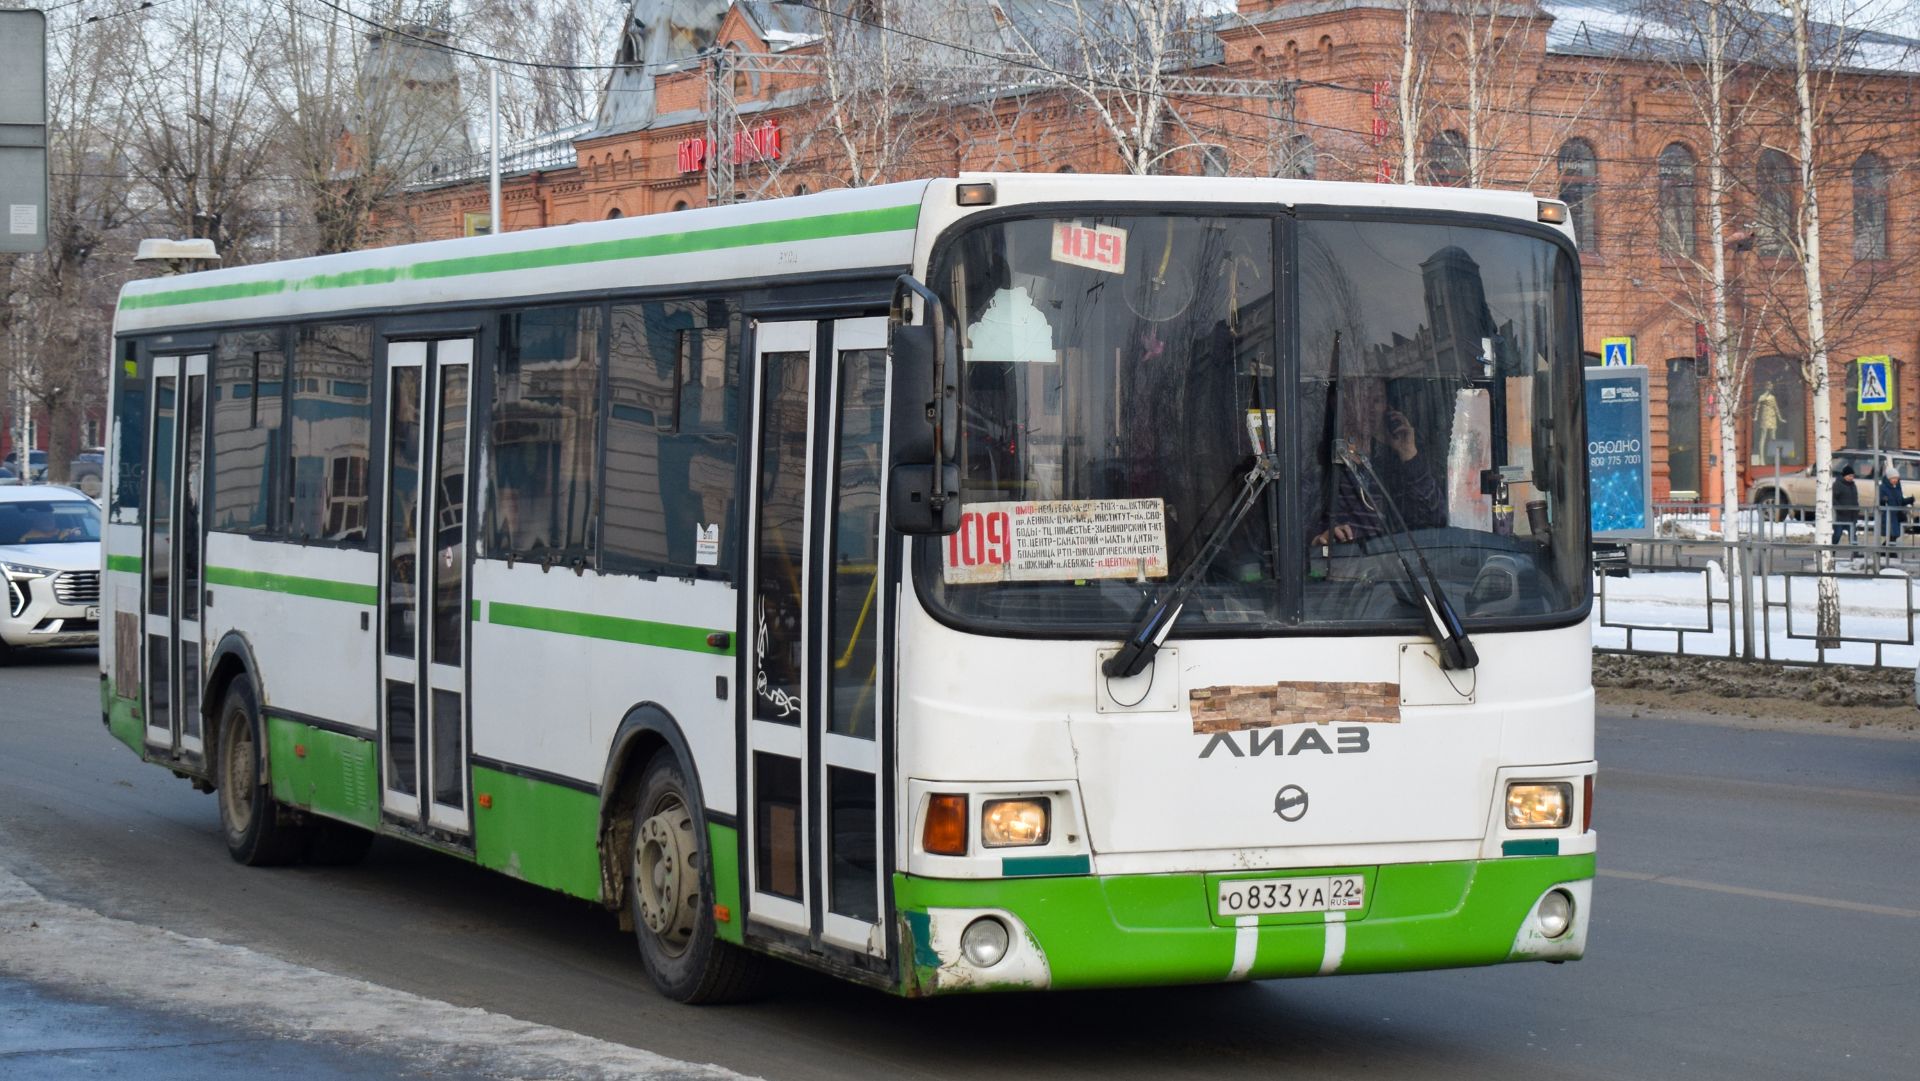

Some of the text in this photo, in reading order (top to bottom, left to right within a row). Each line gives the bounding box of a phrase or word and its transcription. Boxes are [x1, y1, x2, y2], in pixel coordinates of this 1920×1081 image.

[677, 119, 777, 174] КРАНЫЙ
[1060, 226, 1121, 265] 109
[1588, 440, 1641, 455] ОБОДНО
[1608, 455, 1622, 466] 775
[1624, 454, 1641, 465] 7001
[949, 511, 1011, 568] 109
[1198, 725, 1370, 759] ЛИАЗ
[1228, 879, 1355, 910] О833УА 22
[1330, 898, 1347, 906] RUS
